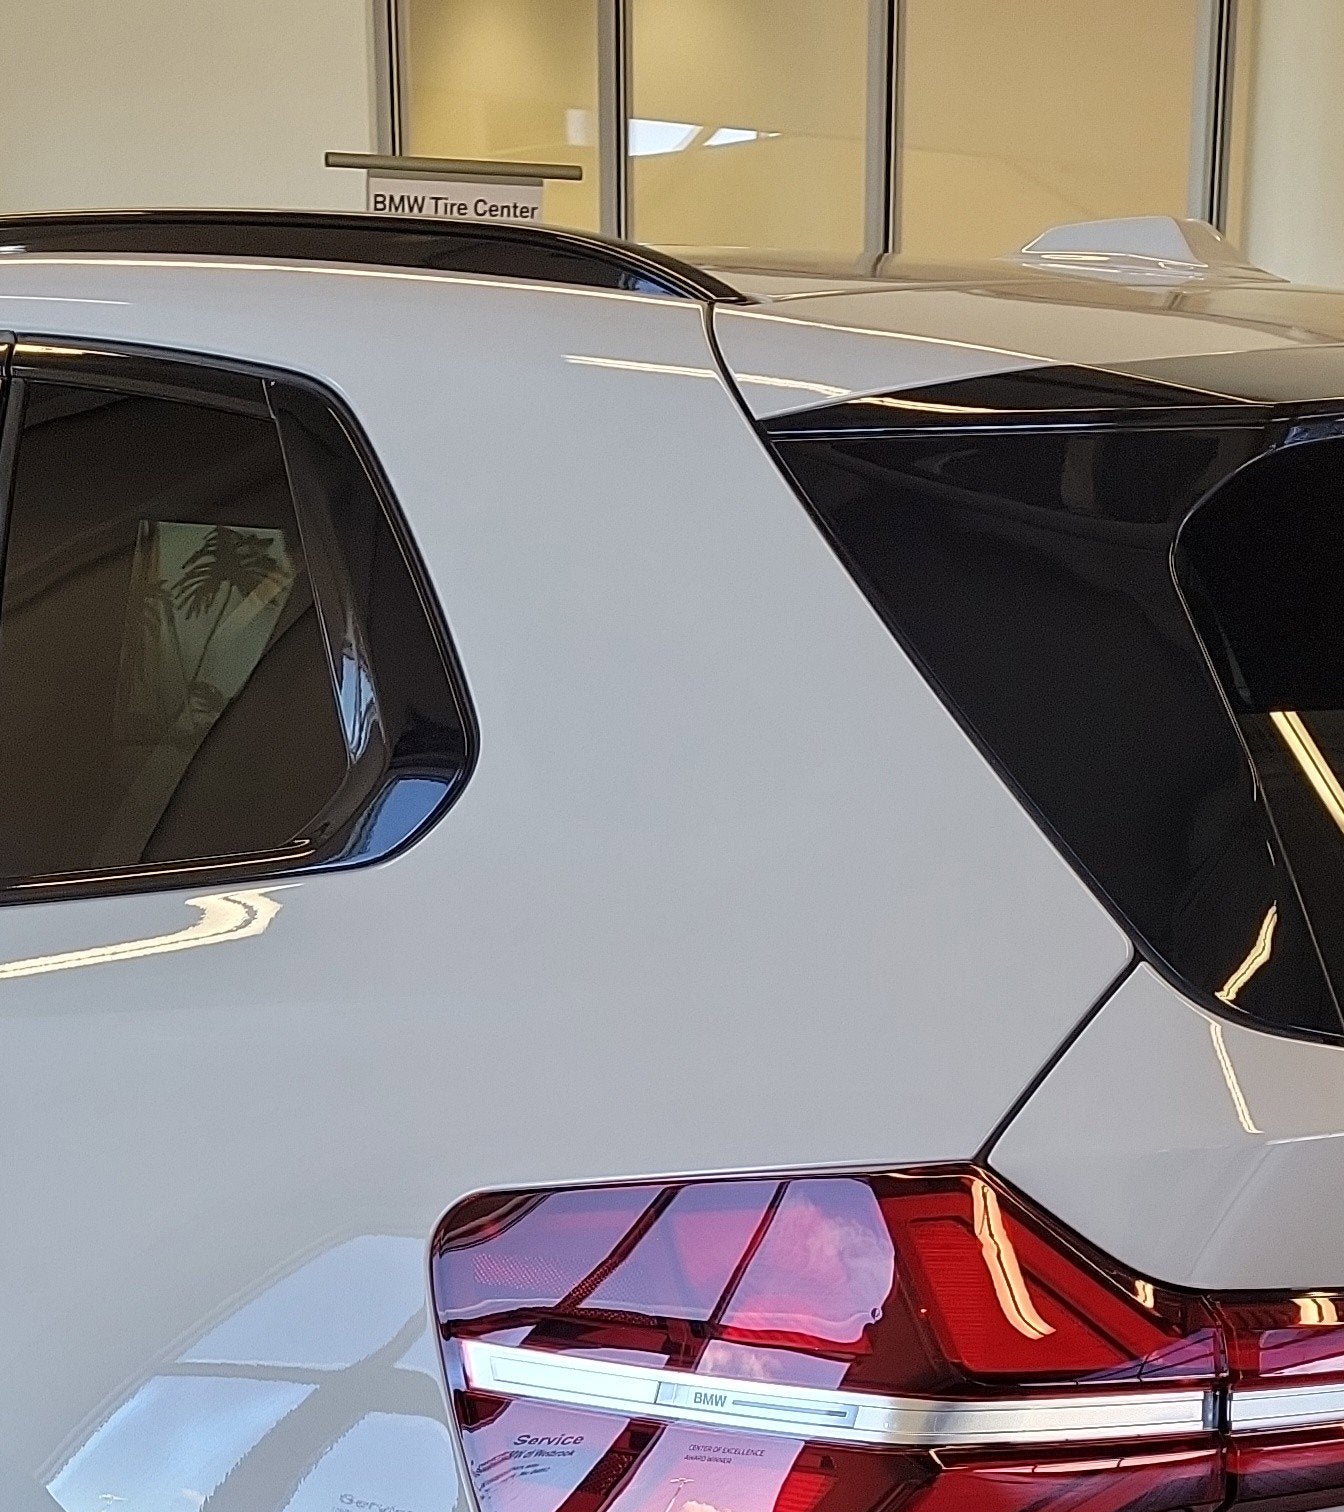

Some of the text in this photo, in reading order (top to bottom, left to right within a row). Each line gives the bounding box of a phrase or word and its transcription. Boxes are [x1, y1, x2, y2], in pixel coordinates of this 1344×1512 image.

[373, 193, 538, 220] BMW Tire Center
[694, 1391, 727, 1407] BMW
[513, 1433, 584, 1446] Service
[688, 1443, 766, 1457] CENTER OF EXCELLENCE
